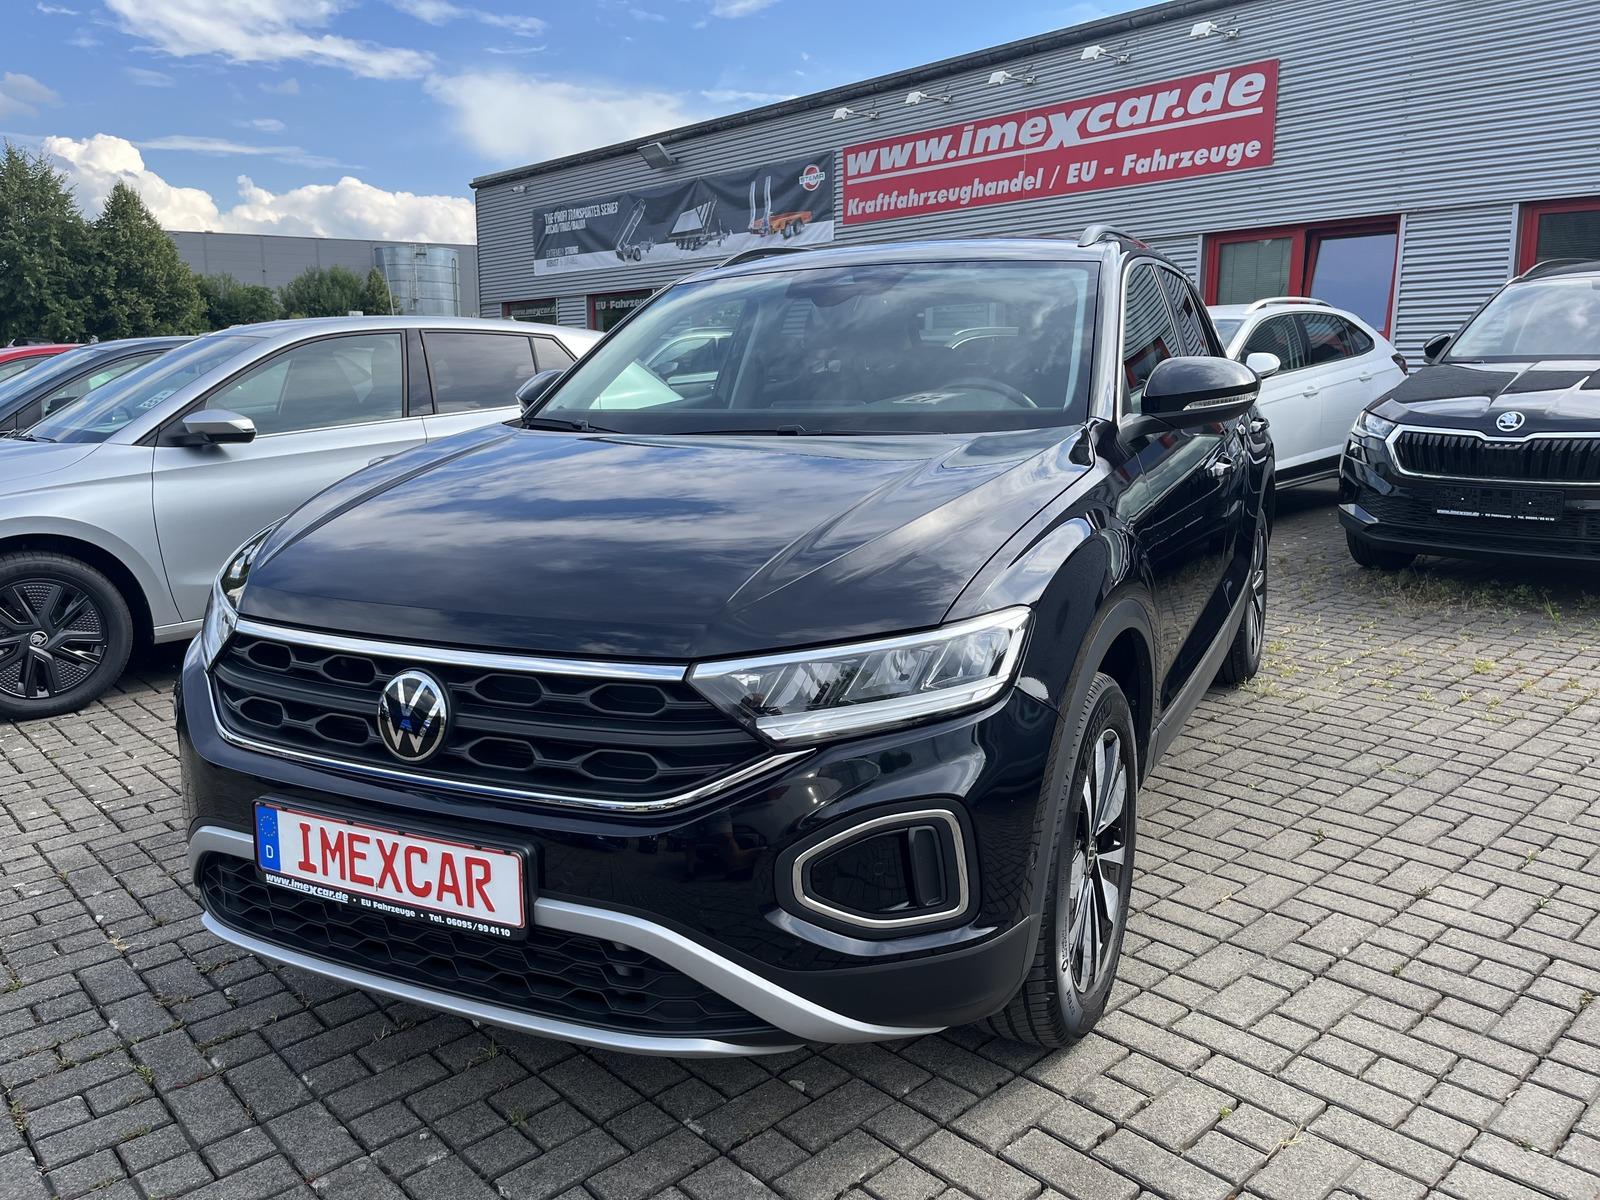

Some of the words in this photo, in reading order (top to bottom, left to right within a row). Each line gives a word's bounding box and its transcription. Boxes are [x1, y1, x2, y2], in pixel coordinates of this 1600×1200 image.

[847, 72, 1266, 177] www.imexcar.de
[847, 168, 1044, 216] Kraftfahrzeughandel
[1066, 160, 1098, 184] EU
[1121, 140, 1261, 176] Fahrzeuge
[265, 845, 274, 859] D
[298, 822, 496, 913] IMEXCAR
[265, 873, 349, 902] www.imexcar.de
[361, 898, 371, 907] EU
[373, 901, 416, 917] Fahrzeuge
[429, 913, 445, 923] Tel.
